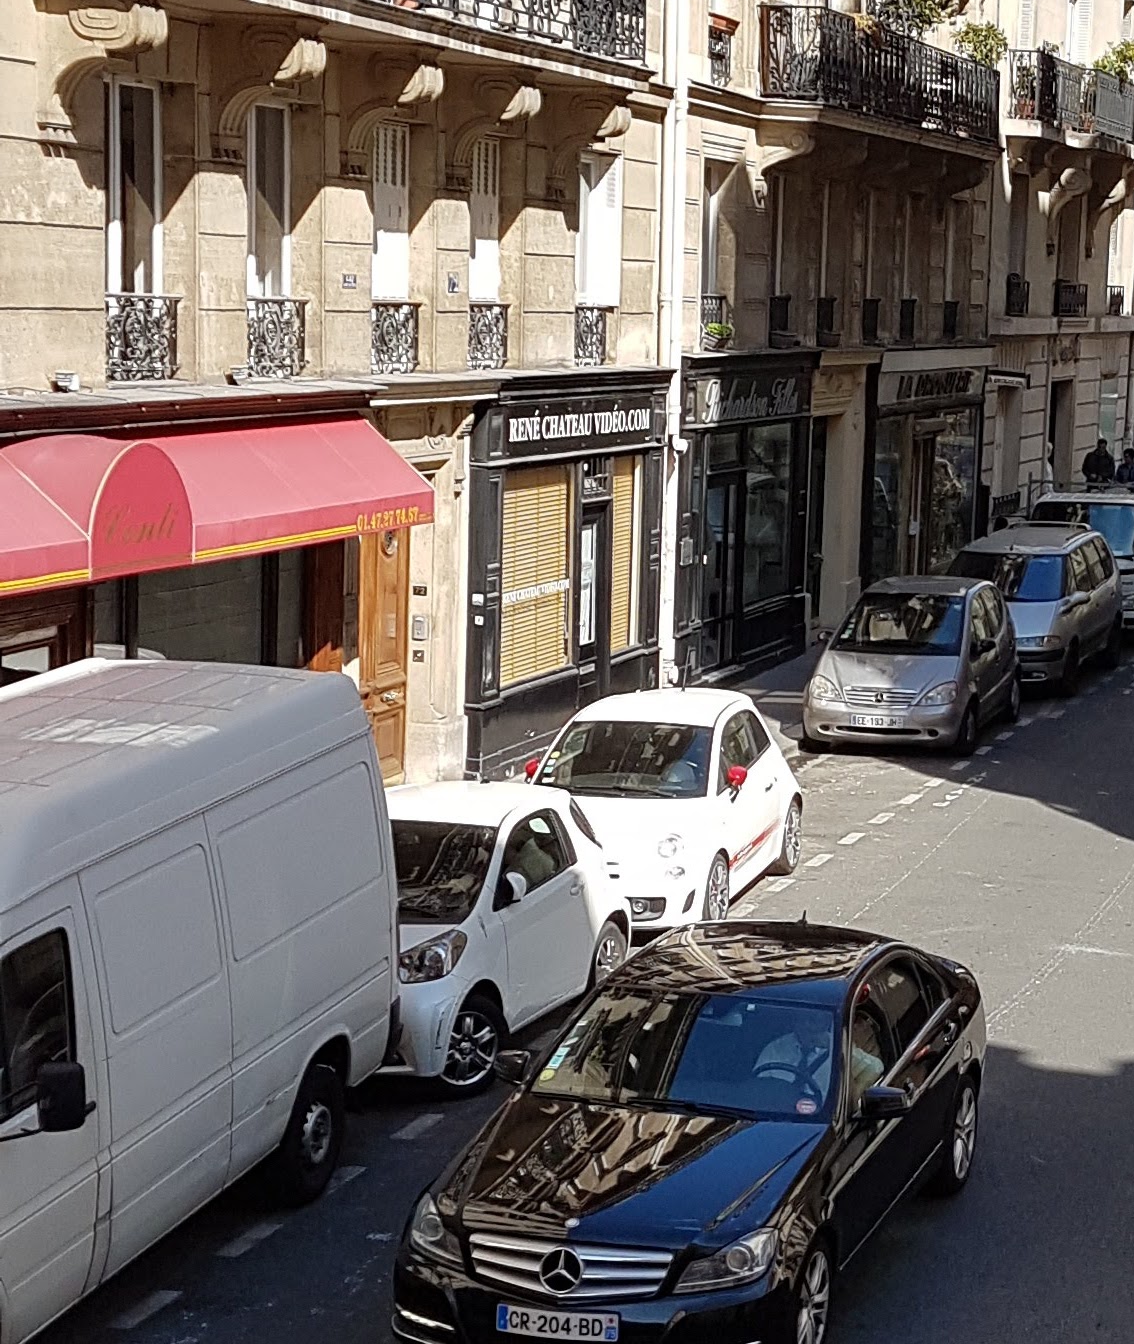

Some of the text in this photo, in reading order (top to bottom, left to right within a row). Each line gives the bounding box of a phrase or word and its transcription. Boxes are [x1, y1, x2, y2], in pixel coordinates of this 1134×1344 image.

[508, 404, 651, 442] RENÉ CHATEAU VIDÉO.COM
[509, 1311, 603, 1337] CR-204-BD
